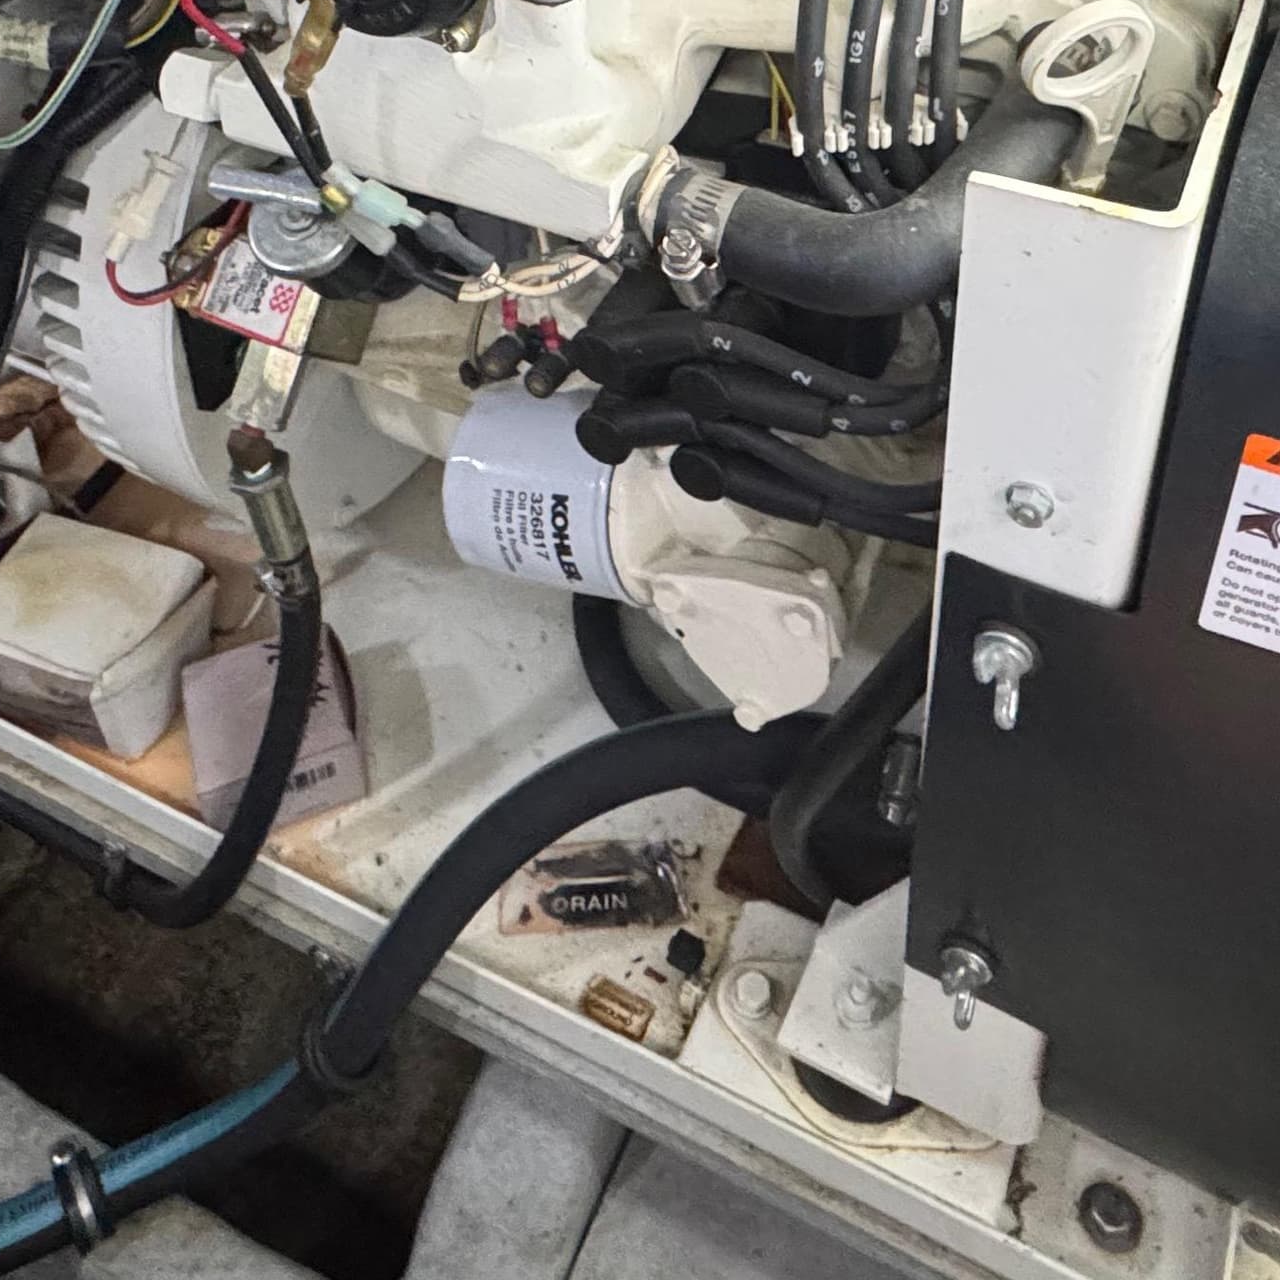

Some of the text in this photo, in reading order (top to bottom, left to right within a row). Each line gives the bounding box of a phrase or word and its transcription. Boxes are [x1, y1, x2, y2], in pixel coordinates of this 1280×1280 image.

[712, 336, 733, 352] 2
[791, 370, 813, 386] 2
[492, 488, 503, 523] Filtro
[504, 490, 515, 524] Filtre
[517, 491, 530, 546] Oil Filter
[530, 492, 552, 562] 326817
[494, 525, 504, 541] de
[551, 493, 584, 582] KOHLER
[1225, 559, 1252, 574] Can
[1220, 576, 1240, 589] Do
[1241, 585, 1264, 597] not
[1214, 599, 1230, 608] all
[1217, 589, 1280, 612] generator
[1212, 610, 1226, 618] or
[1228, 614, 1271, 633] covers
